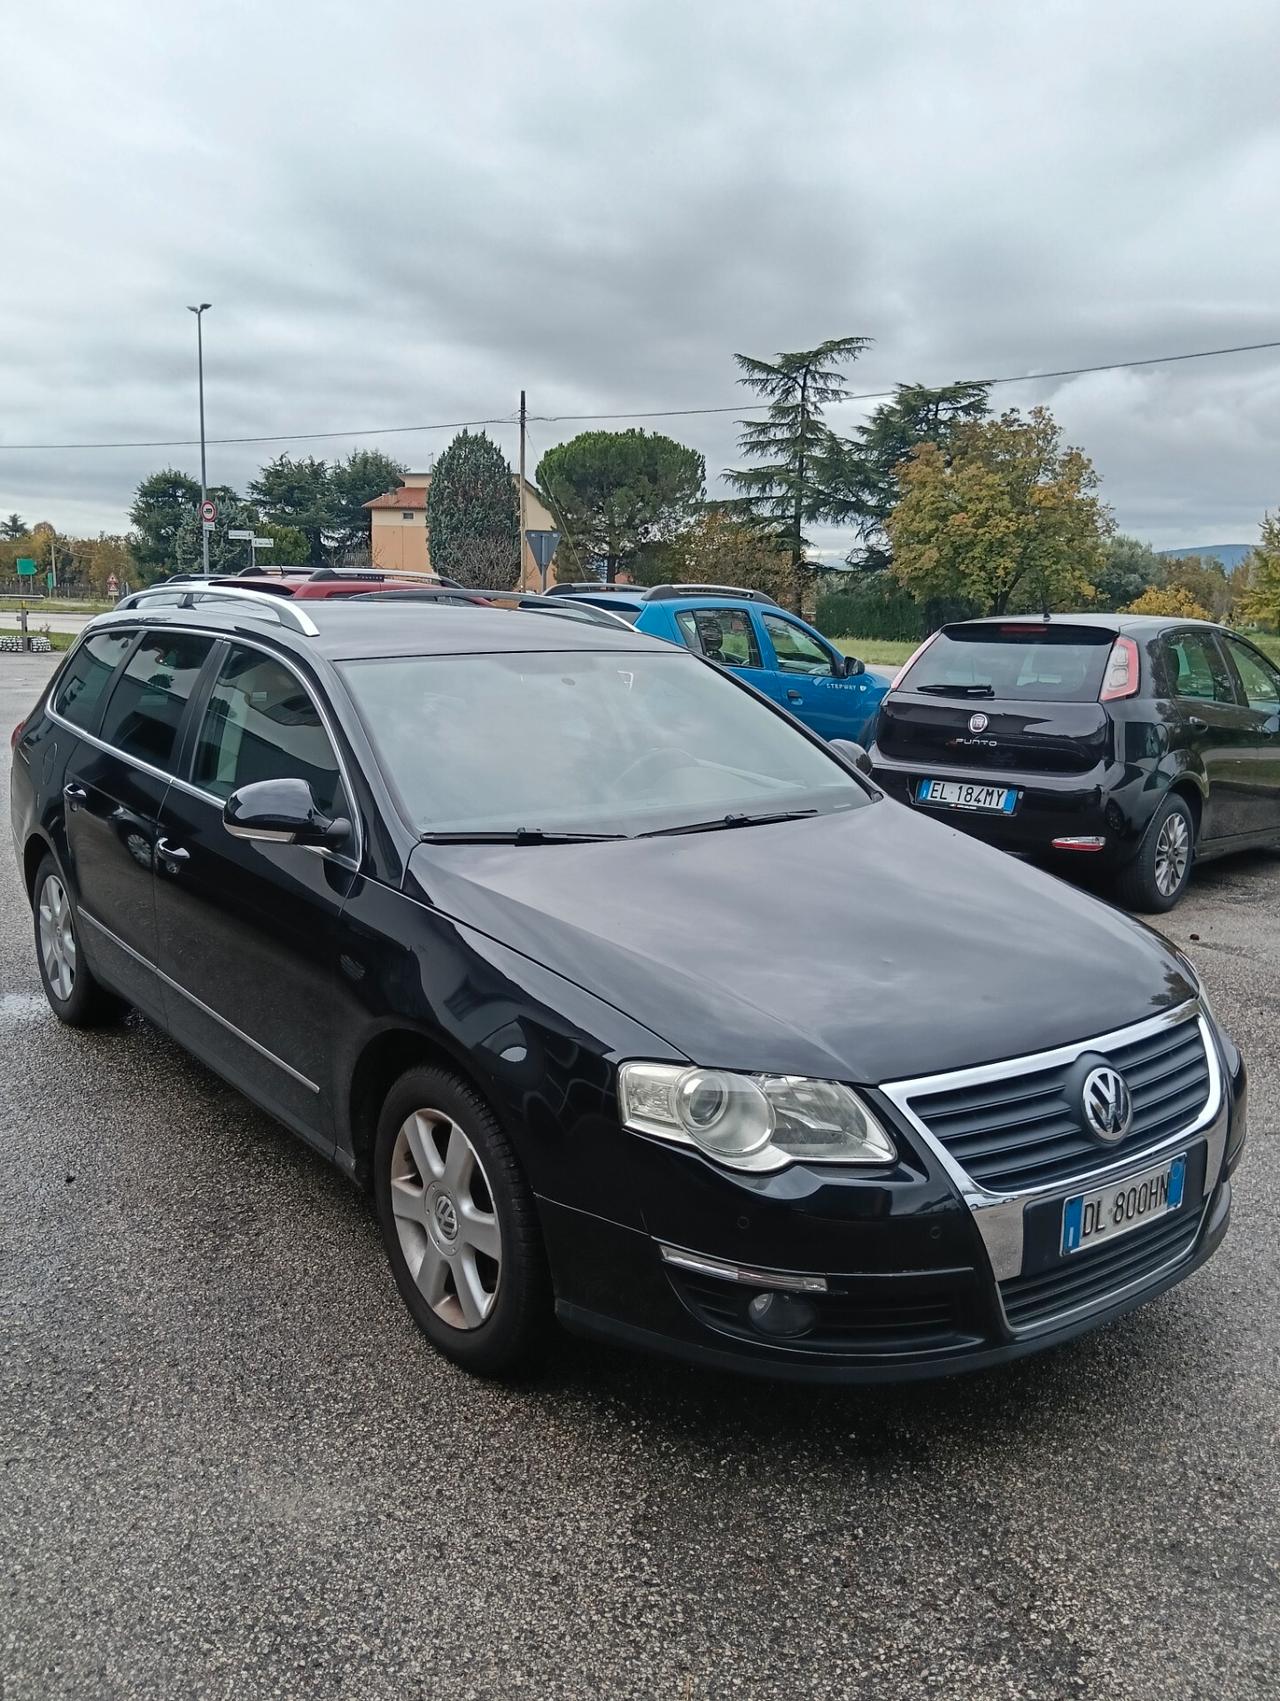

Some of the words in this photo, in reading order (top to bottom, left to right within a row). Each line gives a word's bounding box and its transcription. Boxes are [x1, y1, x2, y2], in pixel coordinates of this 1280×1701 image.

[956, 738, 997, 747] PUNTO
[930, 782, 947, 800] EL
[957, 785, 1005, 807] 184MY
[1082, 1200, 1106, 1237] DL
[1113, 1171, 1170, 1224] 800HN
